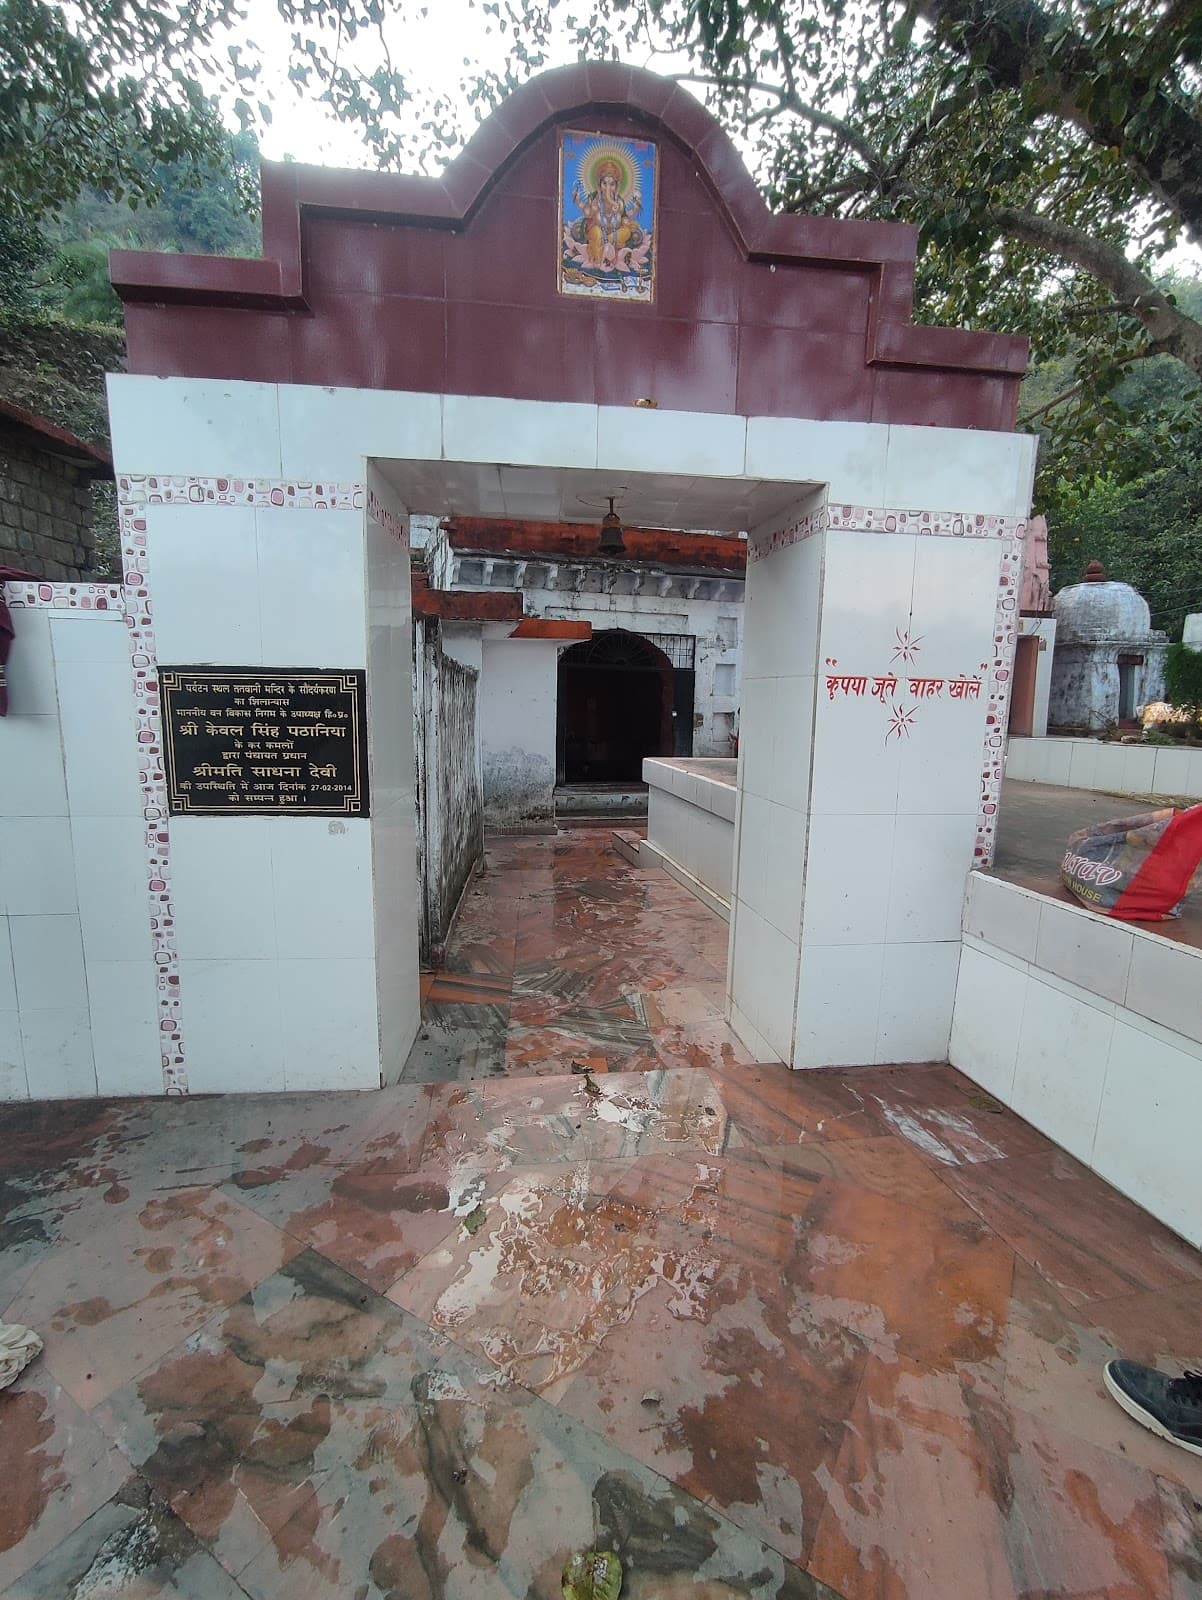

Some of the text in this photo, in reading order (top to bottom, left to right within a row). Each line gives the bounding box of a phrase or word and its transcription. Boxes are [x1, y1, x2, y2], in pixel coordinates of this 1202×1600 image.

[211, 684, 230, 694] स्थल
[288, 682, 296, 694] के
[871, 672, 899, 703] जूते
[234, 696, 290, 706] का शिलान्यास
[176, 707, 207, 718] माननीय
[210, 709, 222, 718] वन
[226, 707, 251, 718] विकास
[255, 708, 276, 718] निगम
[279, 707, 288, 718] के
[290, 709, 321, 719] उपाध्यक्ष
[178, 720, 347, 738] श्री केवल सिंह पठानिया
[233, 739, 294, 750] के कर कमलों
[221, 750, 308, 761] द्वारा पंचायत प्रधान
[192, 762, 338, 778] श्रीमति साधना देवी
[179, 779, 352, 791] की उपस्थिति में आज दिनांक 27-02-2014
[228, 791, 240, 802] को
[244, 793, 274, 802] सम्पन्न
[279, 793, 298, 804] हुआ
[1072, 882, 1103, 903] HOUSE
